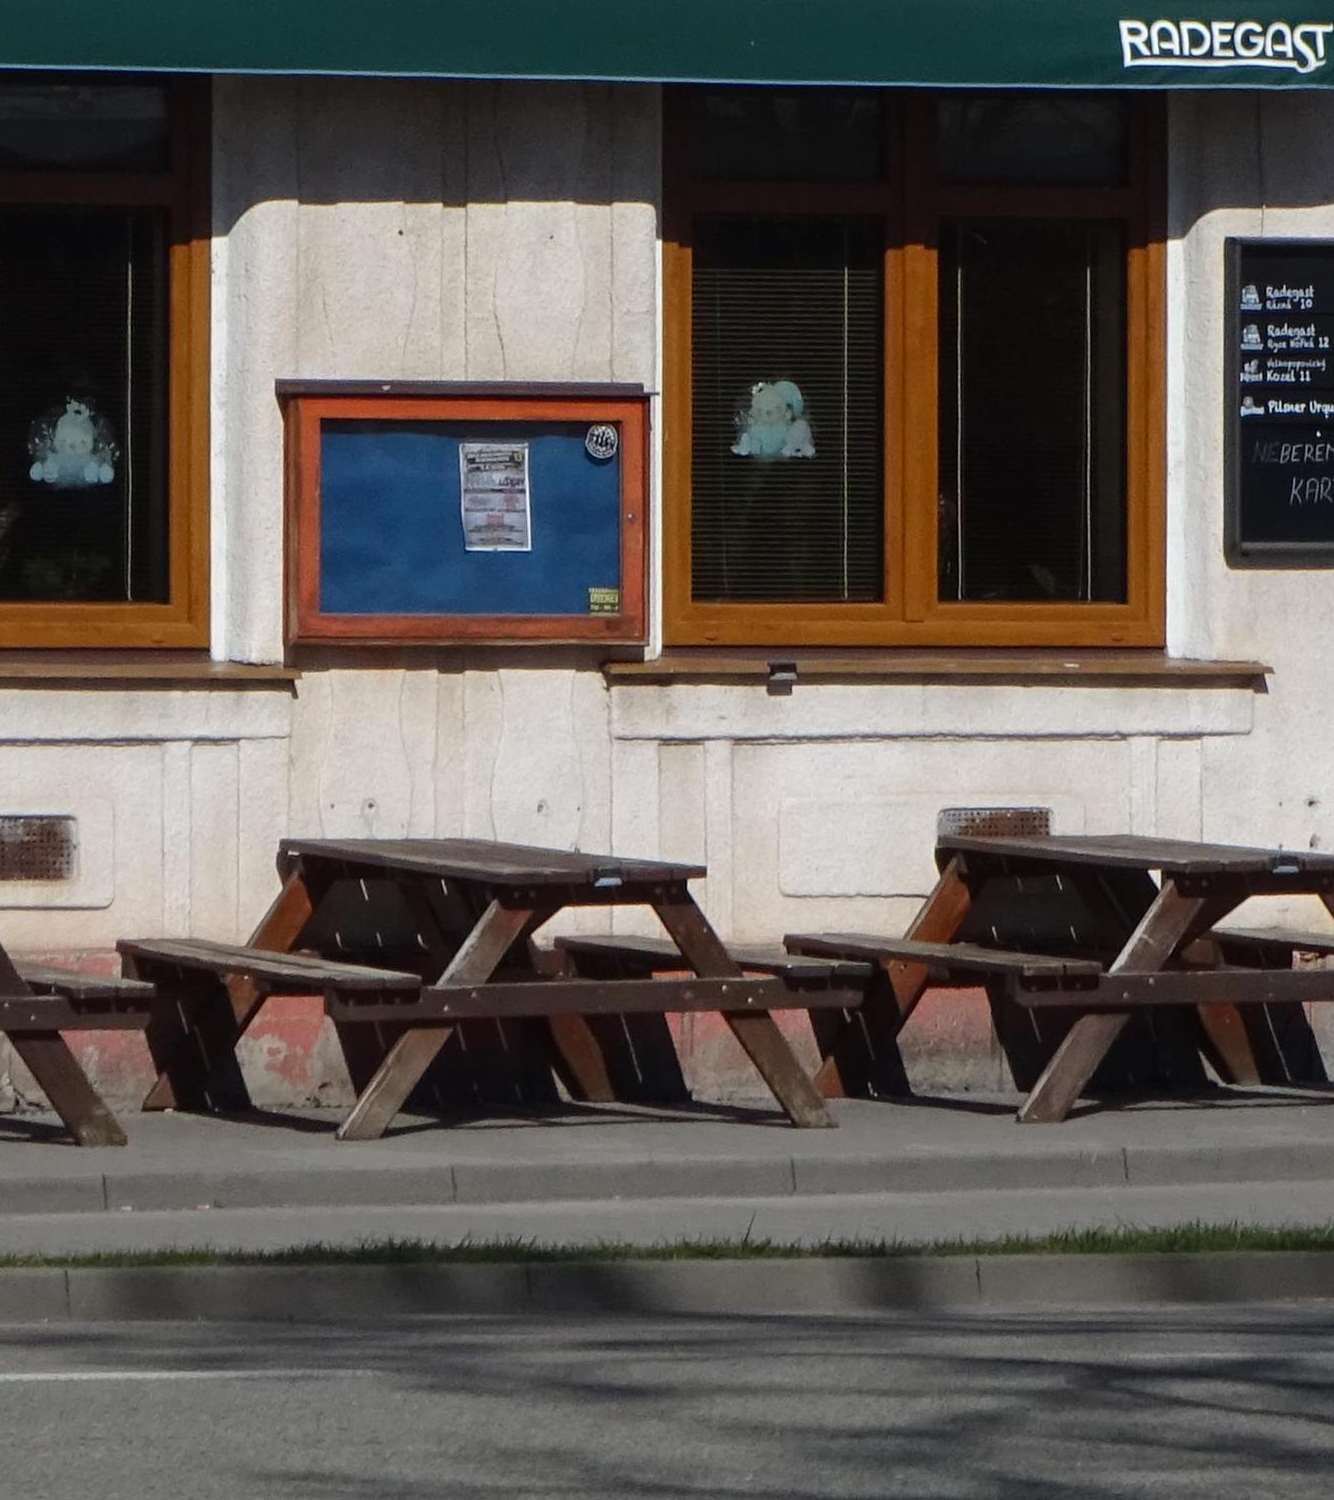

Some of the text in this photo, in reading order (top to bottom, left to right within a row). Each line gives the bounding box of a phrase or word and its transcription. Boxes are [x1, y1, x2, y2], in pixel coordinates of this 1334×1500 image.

[1118, 18, 1334, 74] RADEGAST
[1266, 284, 1315, 302] Radegast
[1300, 299, 1313, 310] 10
[1267, 323, 1316, 340] Radegast
[1318, 336, 1330, 349] 12
[1267, 370, 1296, 383] Kozel
[1300, 370, 1312, 383] 11
